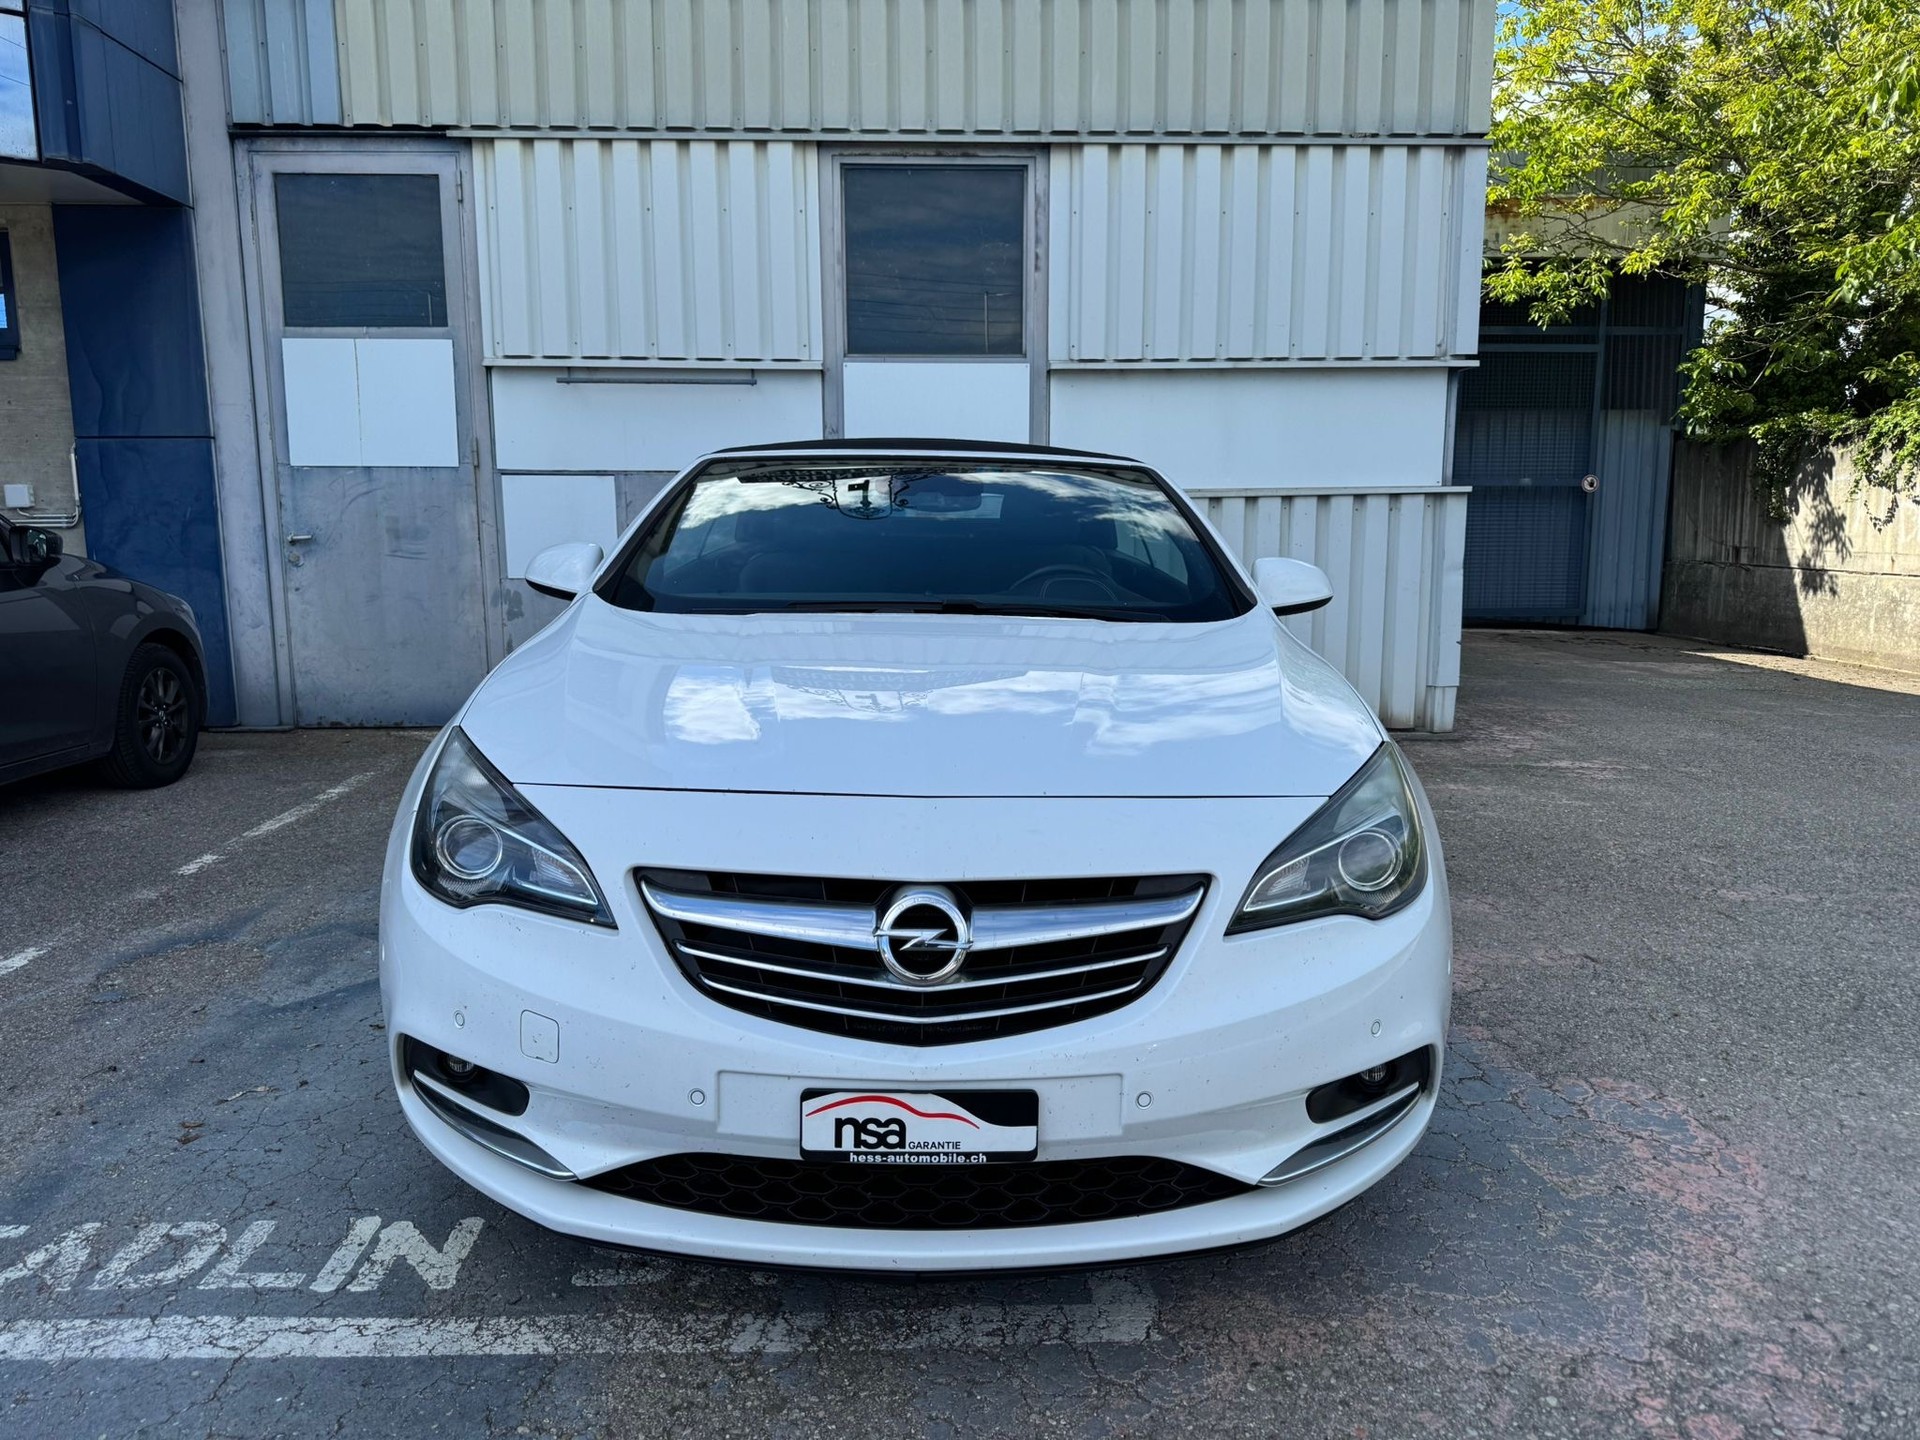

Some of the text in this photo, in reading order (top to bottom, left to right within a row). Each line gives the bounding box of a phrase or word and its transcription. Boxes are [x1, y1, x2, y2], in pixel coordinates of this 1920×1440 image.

[834, 1117, 961, 1150] nsa GARANTIE
[850, 1152, 987, 1163] hess-automobile.ch
[0, 1216, 485, 1293] ADLIN
